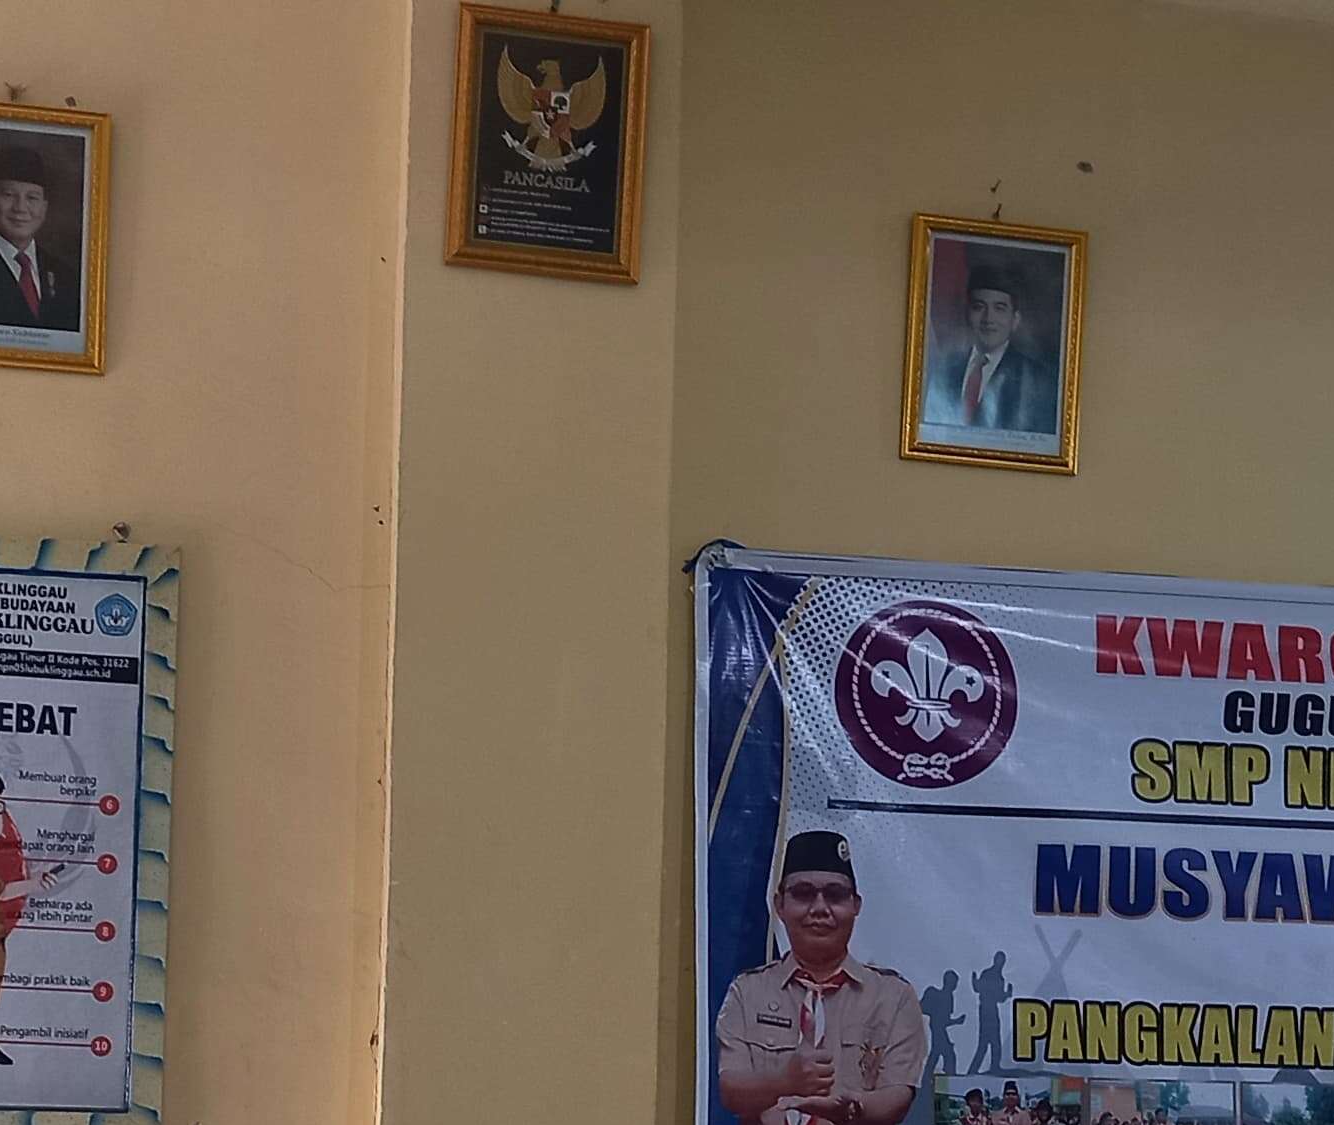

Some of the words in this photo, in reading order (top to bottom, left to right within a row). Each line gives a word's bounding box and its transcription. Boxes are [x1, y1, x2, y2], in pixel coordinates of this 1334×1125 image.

[504, 170, 591, 193] PANCASILA
[20, 652, 45, 664] Timur
[57, 655, 79, 667] Kode
[19, 770, 67, 784] Membuat
[70, 775, 97, 789] orang
[1130, 738, 1269, 808] SMP
[60, 785, 97, 799] berpikir
[37, 829, 95, 844] Menghargai
[47, 844, 75, 855] orang
[77, 844, 95, 854] lain
[29, 898, 73, 912] Berharap
[75, 901, 93, 912] ada
[37, 911, 61, 921] lebih
[63, 911, 93, 924] pintar
[34, 974, 67, 986] praktik
[70, 976, 90, 986] baik
[0, 1025, 51, 1039] Pengambil
[54, 1027, 89, 1039] inisiatif
[95, 1041, 108, 1051] 10
